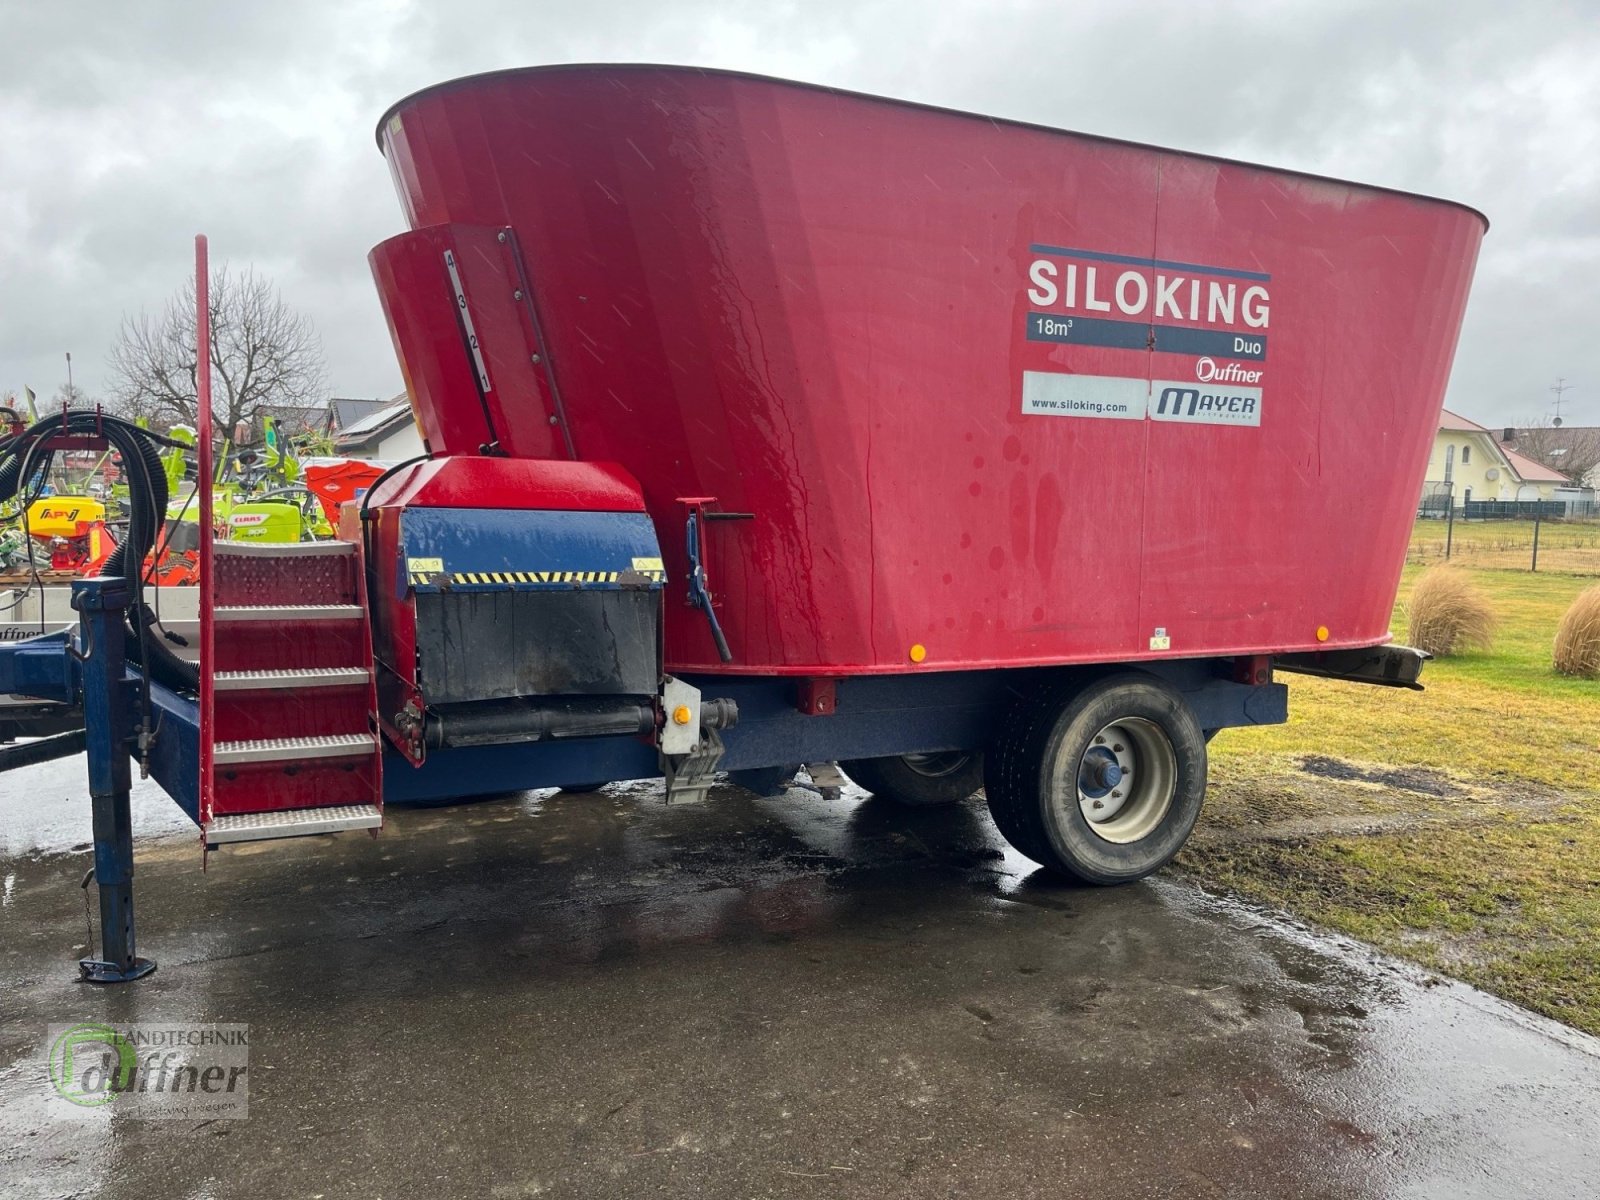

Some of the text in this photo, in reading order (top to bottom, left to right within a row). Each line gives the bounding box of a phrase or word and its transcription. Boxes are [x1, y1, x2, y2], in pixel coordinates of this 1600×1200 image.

[448, 255, 455, 269] 4
[458, 294, 466, 309] 3
[1027, 259, 1271, 329] SILOKING
[470, 335, 478, 349] 2
[1234, 337, 1262, 355] Duo
[1196, 356, 1263, 383] Duffner
[481, 375, 489, 388] 1
[1031, 398, 1128, 414] www.siloking.com
[1156, 387, 1256, 416] MAYER
